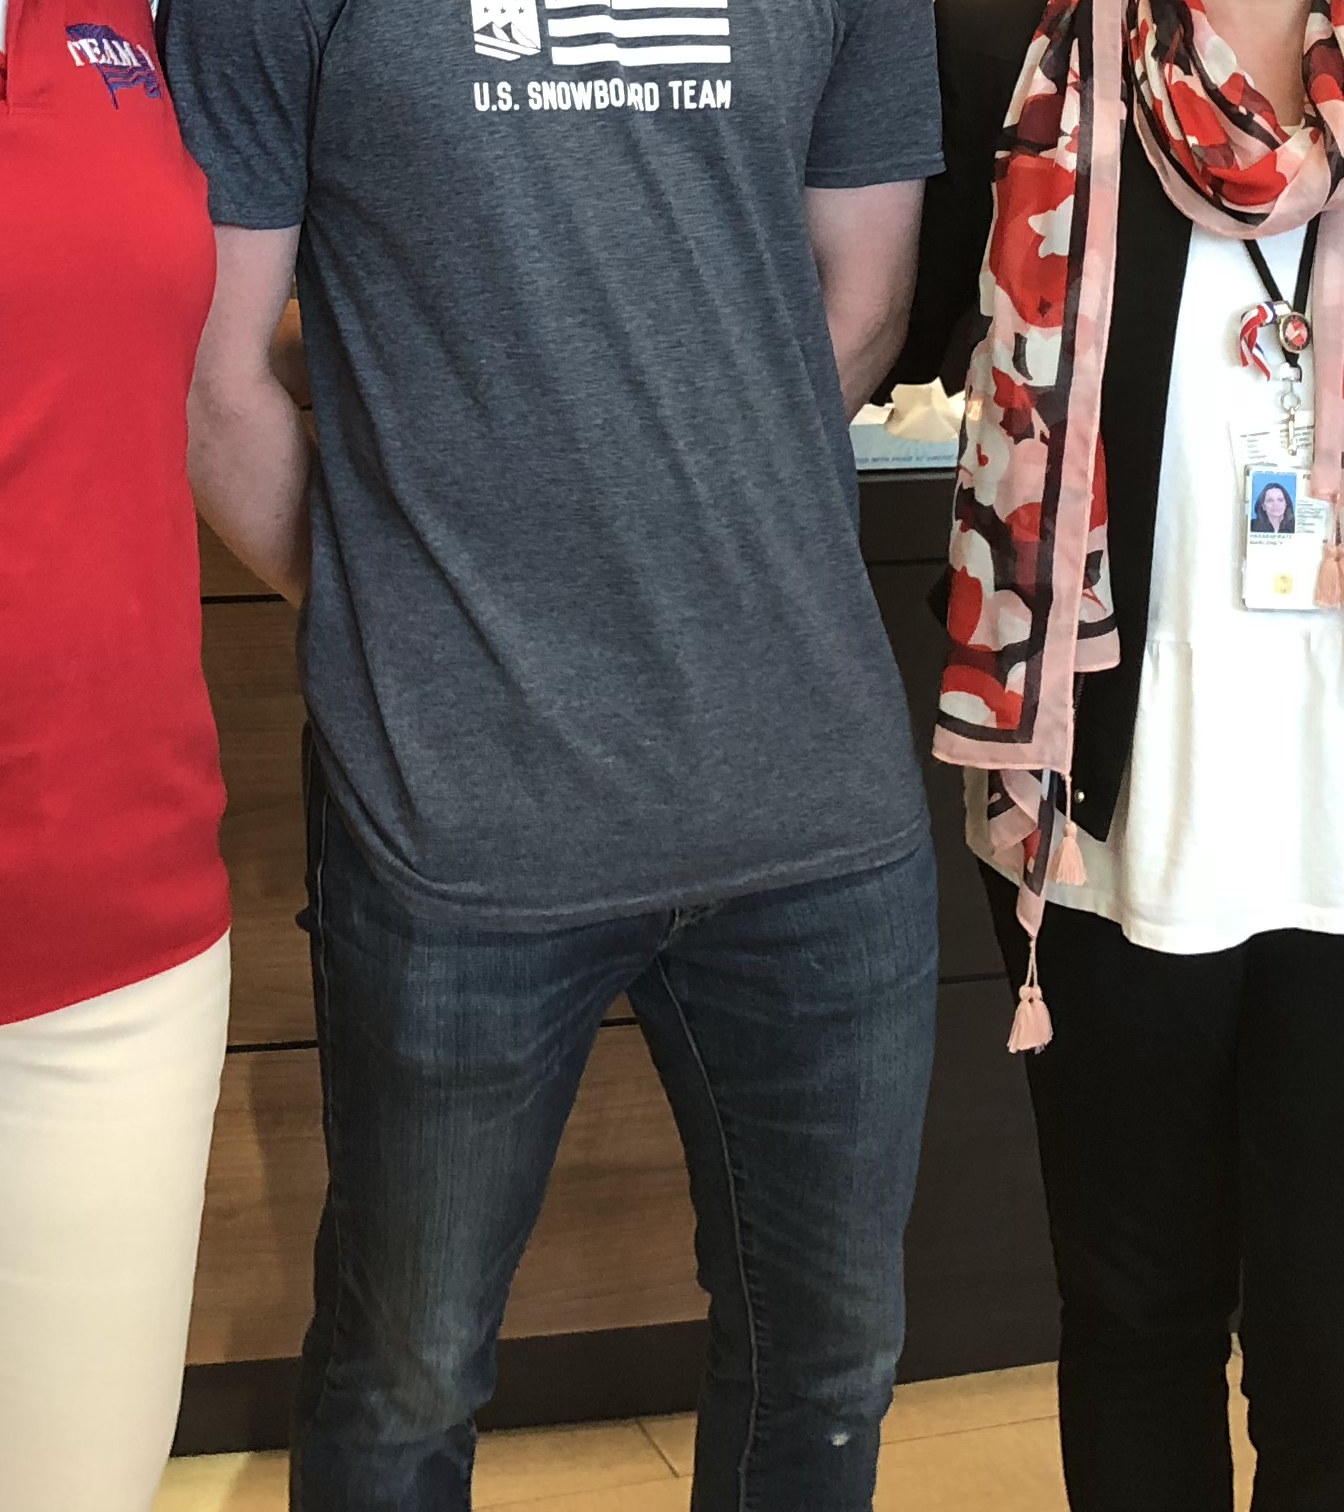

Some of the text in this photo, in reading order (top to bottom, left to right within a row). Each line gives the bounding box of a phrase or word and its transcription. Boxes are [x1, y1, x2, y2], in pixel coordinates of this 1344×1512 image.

[66, 38, 142, 68] TEAM
[473, 78, 733, 113] U.S. SNOWBORD TEAM
